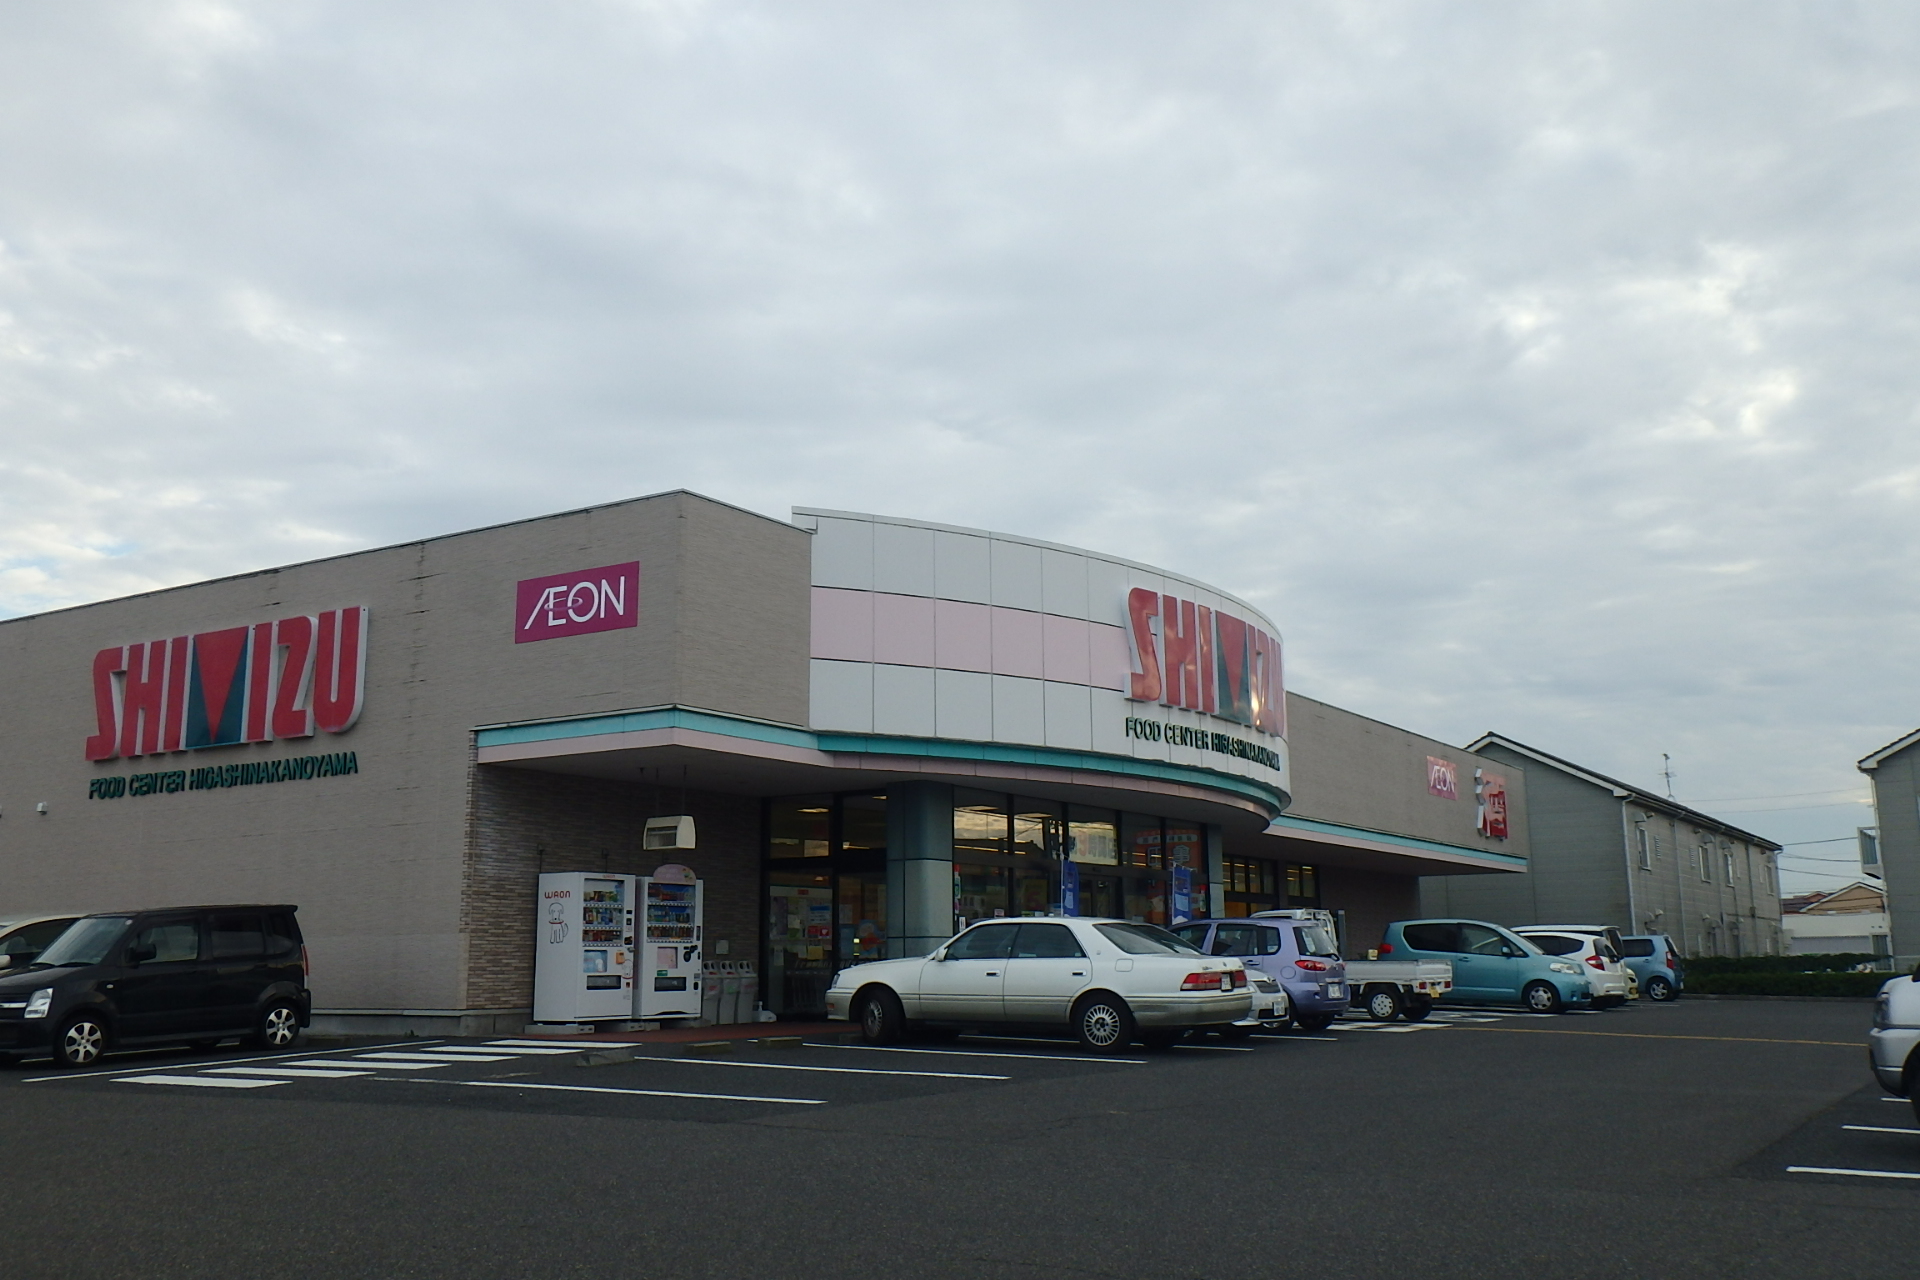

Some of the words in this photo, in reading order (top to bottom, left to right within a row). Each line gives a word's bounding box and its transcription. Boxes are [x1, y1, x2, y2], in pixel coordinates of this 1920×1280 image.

[85, 606, 369, 761] SHIMIZU
[1123, 587, 1285, 736] SHIMIZU
[1126, 717, 1161, 741] FOOD
[1164, 723, 1209, 750] CENTER
[88, 776, 126, 800] FOOD
[129, 770, 187, 797] CENTER
[189, 751, 359, 790] HIGASHINAKANOYAMA
[1475, 768, 1508, 841] 酒
[544, 890, 571, 899] WAON
